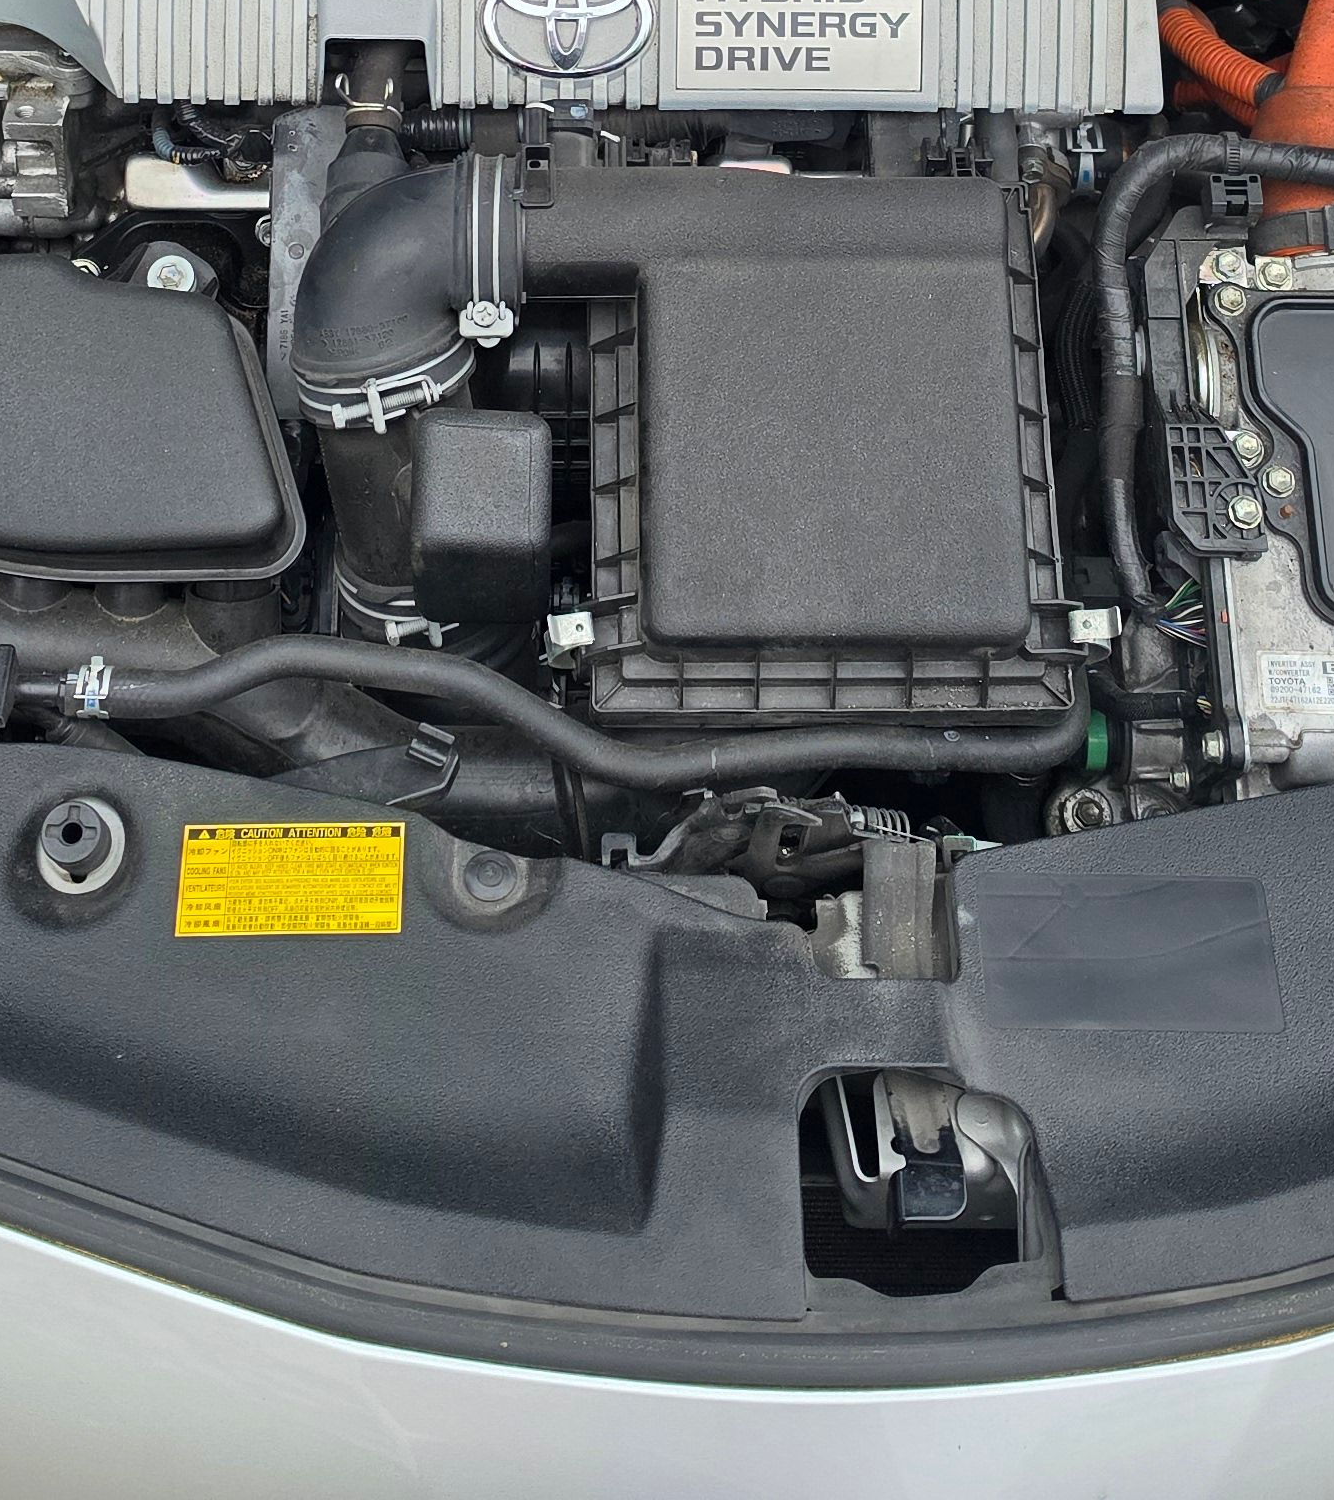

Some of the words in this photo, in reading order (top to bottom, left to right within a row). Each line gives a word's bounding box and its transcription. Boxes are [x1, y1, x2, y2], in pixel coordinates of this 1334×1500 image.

[695, 12, 910, 39] SYNERGY
[695, 47, 831, 71] DRIVE
[1268, 678, 1306, 686] TOYOTA
[241, 829, 284, 838] CAUTION
[288, 828, 342, 837] ATTENTION
[187, 867, 210, 875] COOLING
[213, 866, 227, 874] FANS
[185, 884, 226, 892] VENTILATEURS
